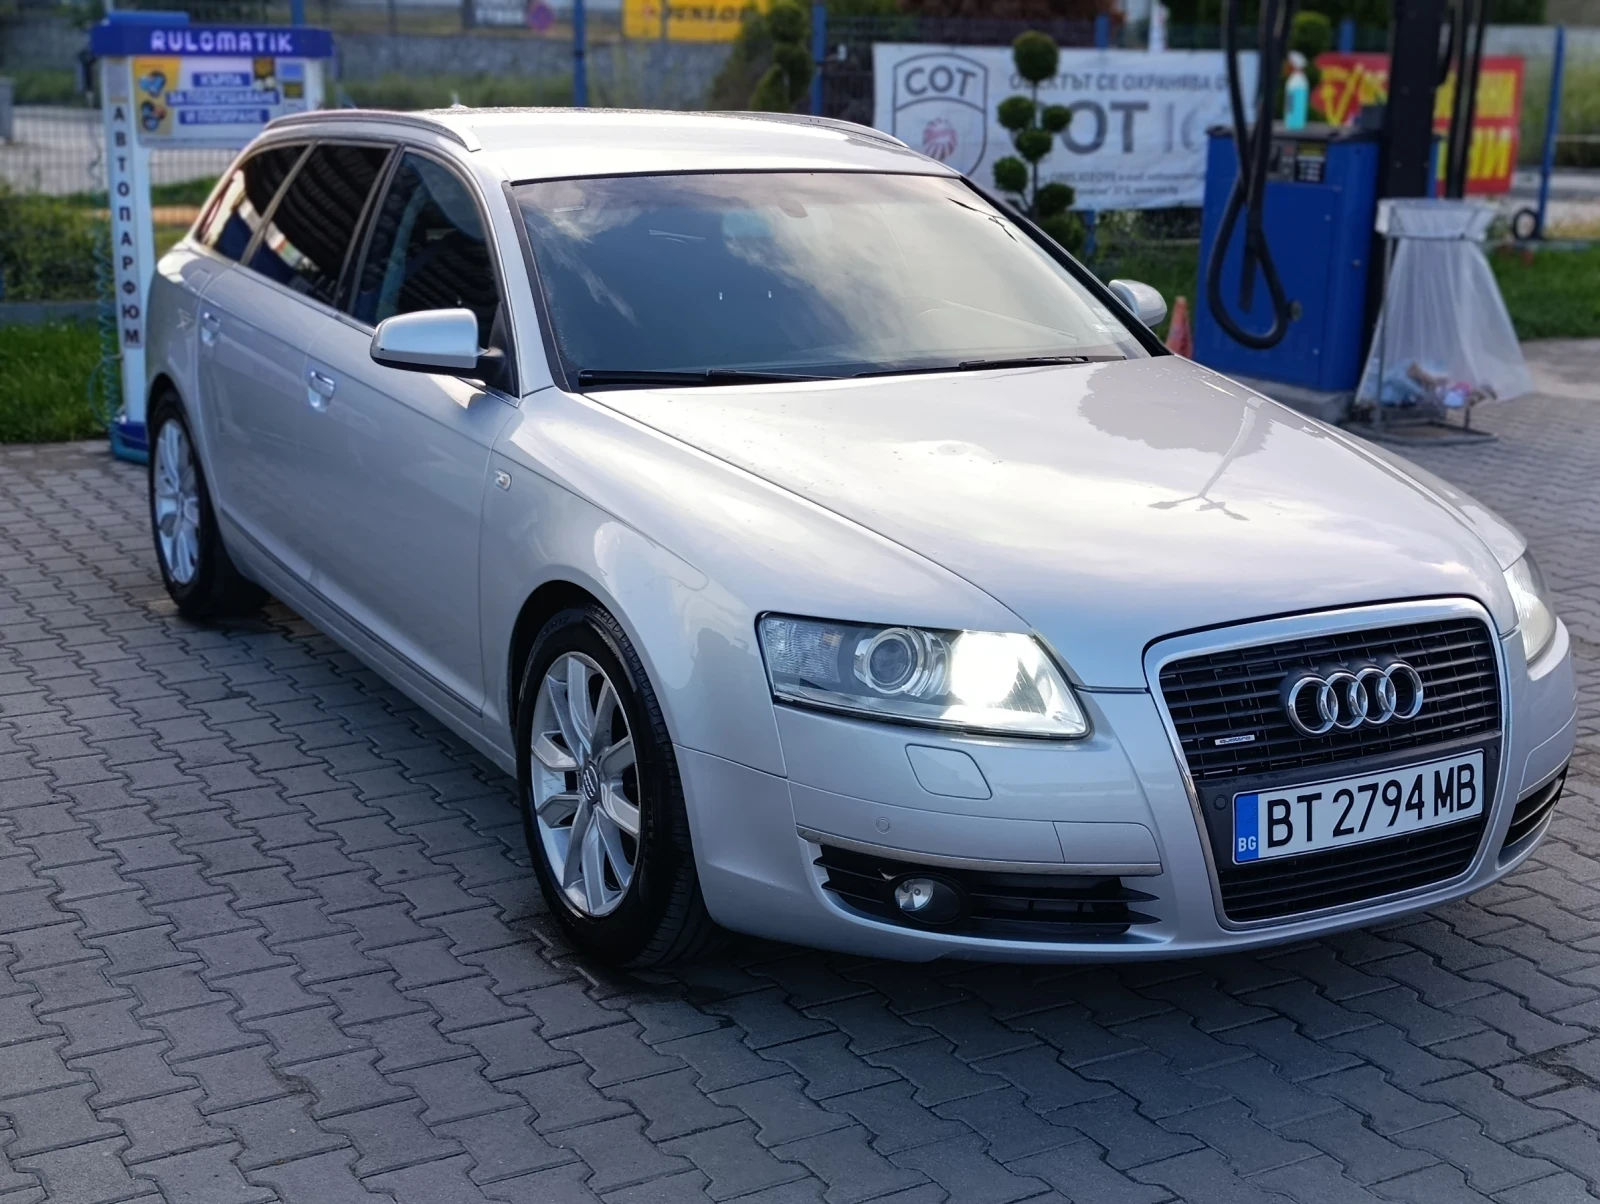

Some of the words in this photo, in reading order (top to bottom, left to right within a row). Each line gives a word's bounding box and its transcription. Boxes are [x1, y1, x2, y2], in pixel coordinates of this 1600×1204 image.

[114, 106, 140, 343] АВТОПАРФЮМ
[1238, 837, 1257, 852] BG
[1267, 792, 1322, 848] BT
[1332, 773, 1425, 838] 2794
[1433, 763, 1477, 817] MB
